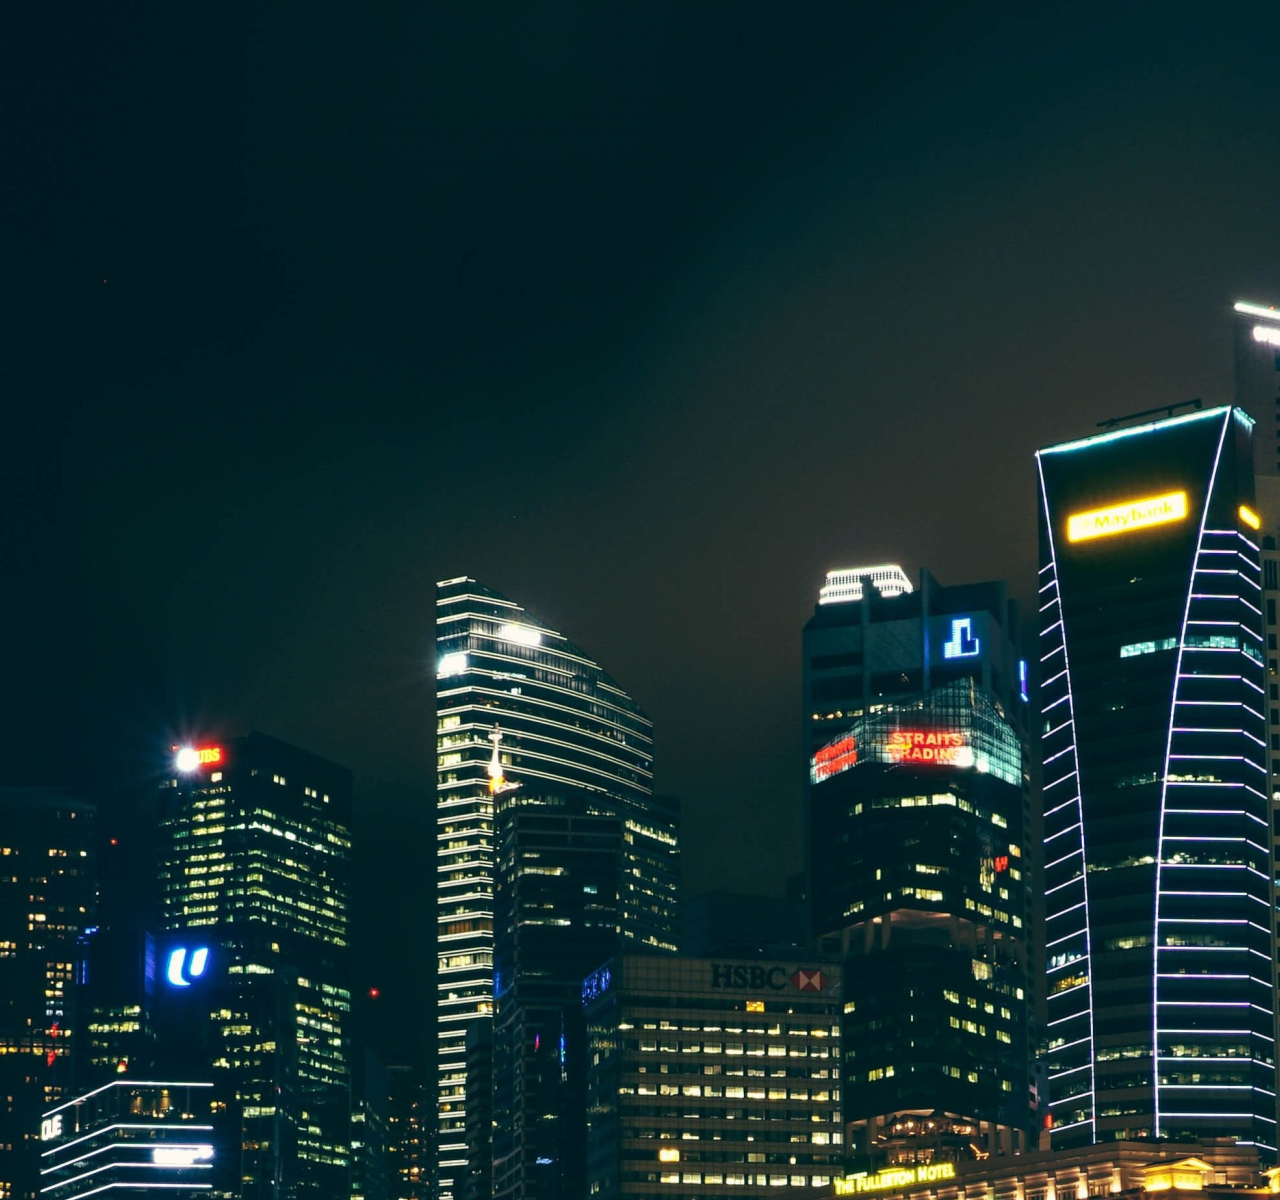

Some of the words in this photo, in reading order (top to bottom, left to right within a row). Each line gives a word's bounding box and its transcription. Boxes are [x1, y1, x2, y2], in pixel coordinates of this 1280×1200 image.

[1095, 501, 1173, 528] Maybank
[893, 732, 963, 746] STRAITS
[710, 963, 786, 991] HSBC
[834, 1179, 855, 1195] THE
[856, 1168, 915, 1192] FULLERTON
[917, 1163, 956, 1182] HOTEL
